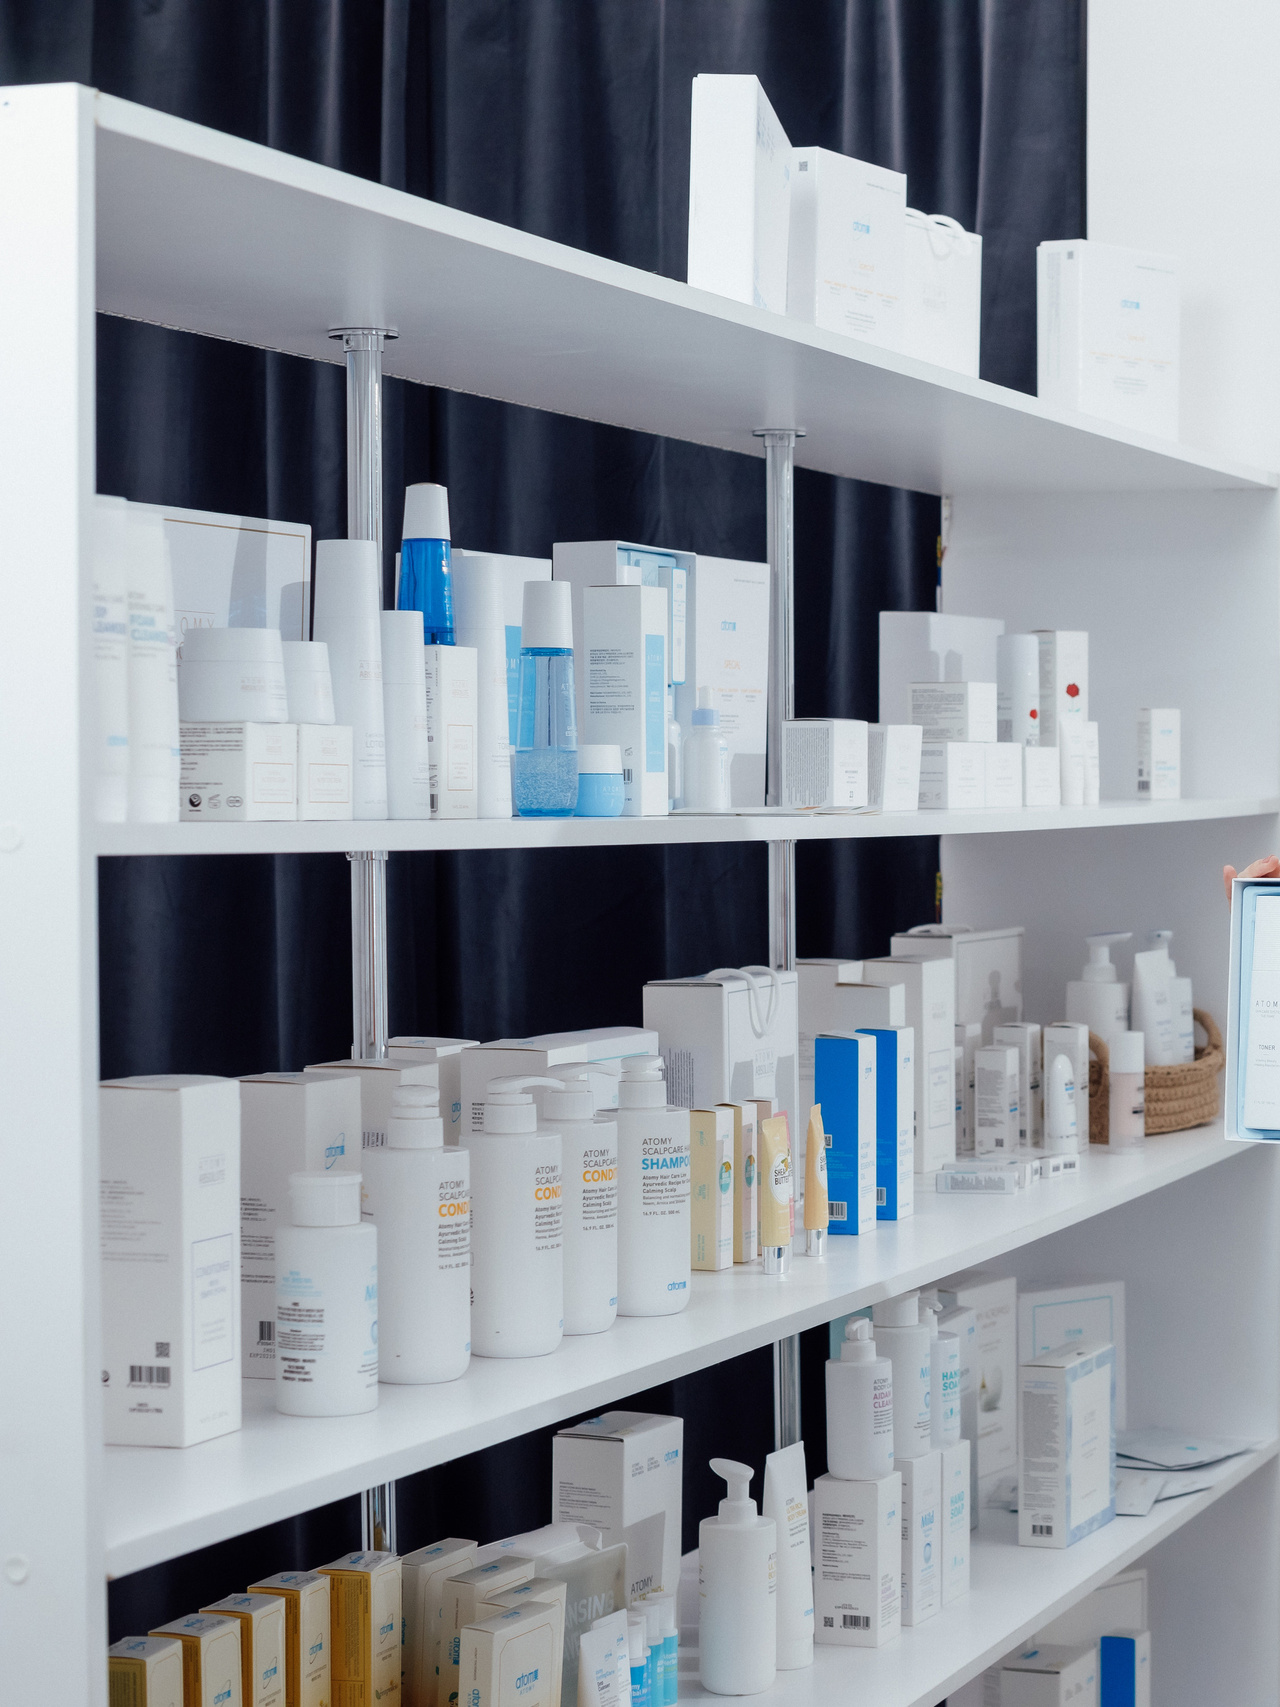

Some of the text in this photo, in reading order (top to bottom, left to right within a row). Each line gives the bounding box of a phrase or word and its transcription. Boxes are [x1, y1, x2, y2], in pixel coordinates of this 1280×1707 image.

[642, 1137, 672, 1146] ATOMY
[583, 1148, 610, 1158] ATOMY
[642, 1145, 684, 1156] SCALPCARE
[535, 1165, 558, 1175] ATOMY
[438, 1180, 465, 1190] ATOMY
[630, 1575, 653, 1595] ATOMY
